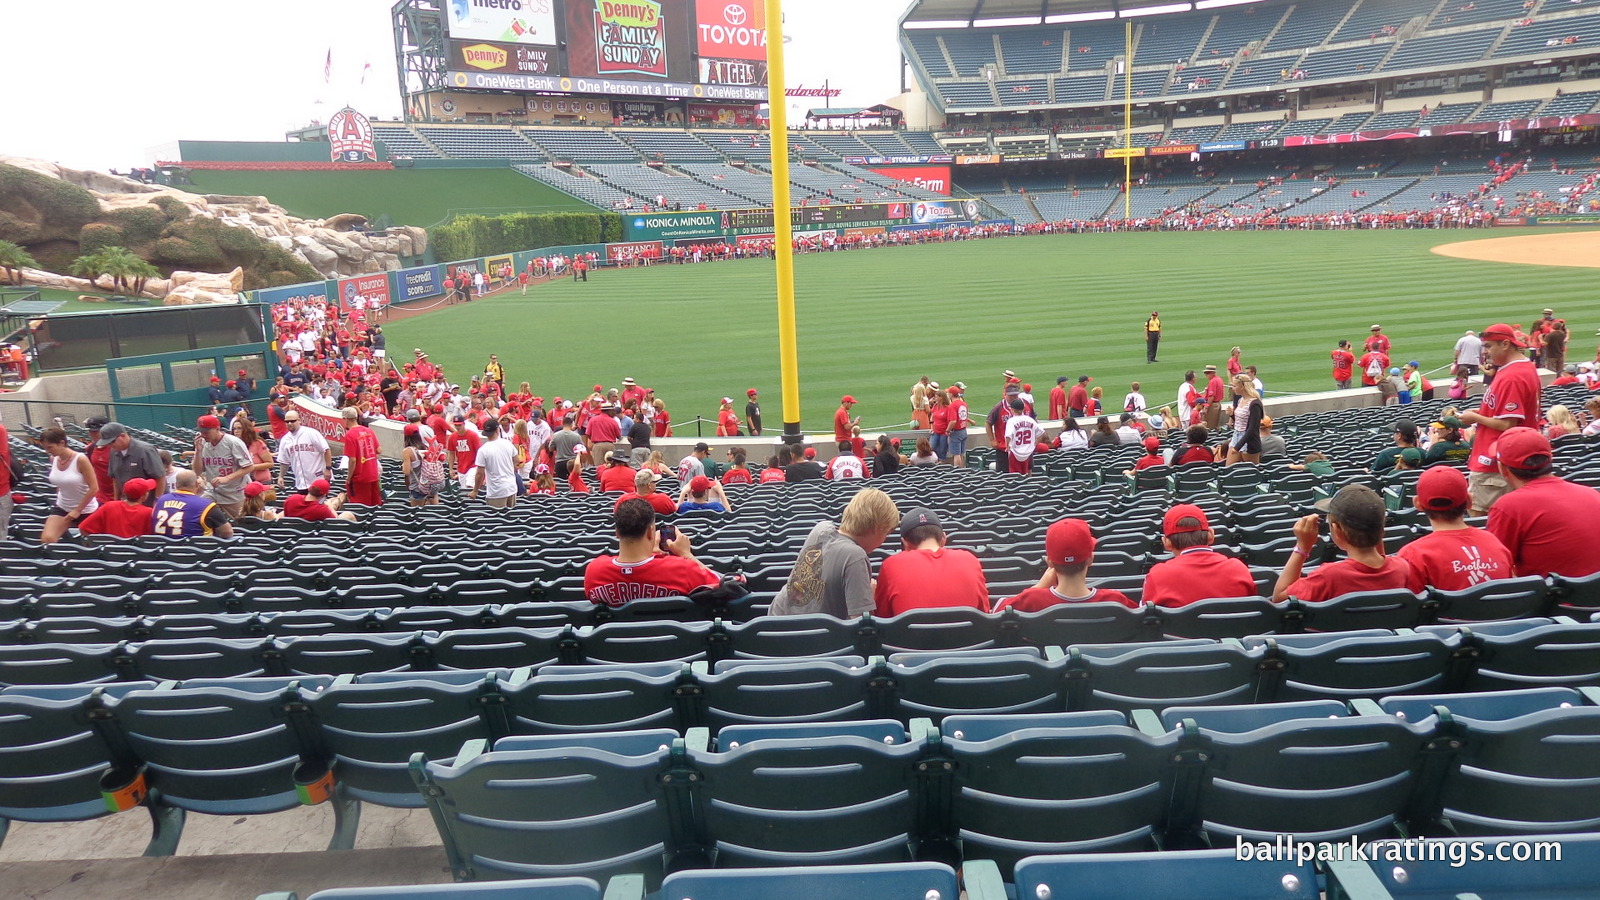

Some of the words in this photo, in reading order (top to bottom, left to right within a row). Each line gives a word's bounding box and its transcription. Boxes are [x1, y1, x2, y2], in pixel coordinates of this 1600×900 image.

[603, 1, 655, 22] Denny's
[602, 21, 658, 45] FAMILY
[466, 49, 504, 64] Denny's
[517, 45, 547, 61] FAMILY
[604, 44, 661, 68] SUNDAY
[518, 60, 548, 74] SUNDAY
[707, 59, 755, 84] ANGELS
[476, 74, 525, 88] OneWest
[527, 79, 553, 90] Bank
[577, 80, 600, 92] One
[603, 81, 639, 94] Person
[642, 85, 652, 94] at
[663, 84, 689, 96] Time
[707, 86, 743, 98] OneWest
[744, 88, 764, 100] Bank
[785, 83, 842, 97] udweiser
[1260, 139, 1278, 147] 11:39
[892, 156, 920, 164] STORAGE
[929, 206, 954, 215] TOTAL
[646, 218, 679, 229] KONICA
[680, 216, 716, 227] MINOLTA
[358, 278, 385, 289] Insurance
[406, 271, 432, 285] freecredit
[407, 284, 435, 296] score.com
[1015, 430, 1031, 446] 32
[203, 457, 236, 467] NGELS
[155, 509, 185, 536] 24
[1451, 558, 1499, 574] Brother's
